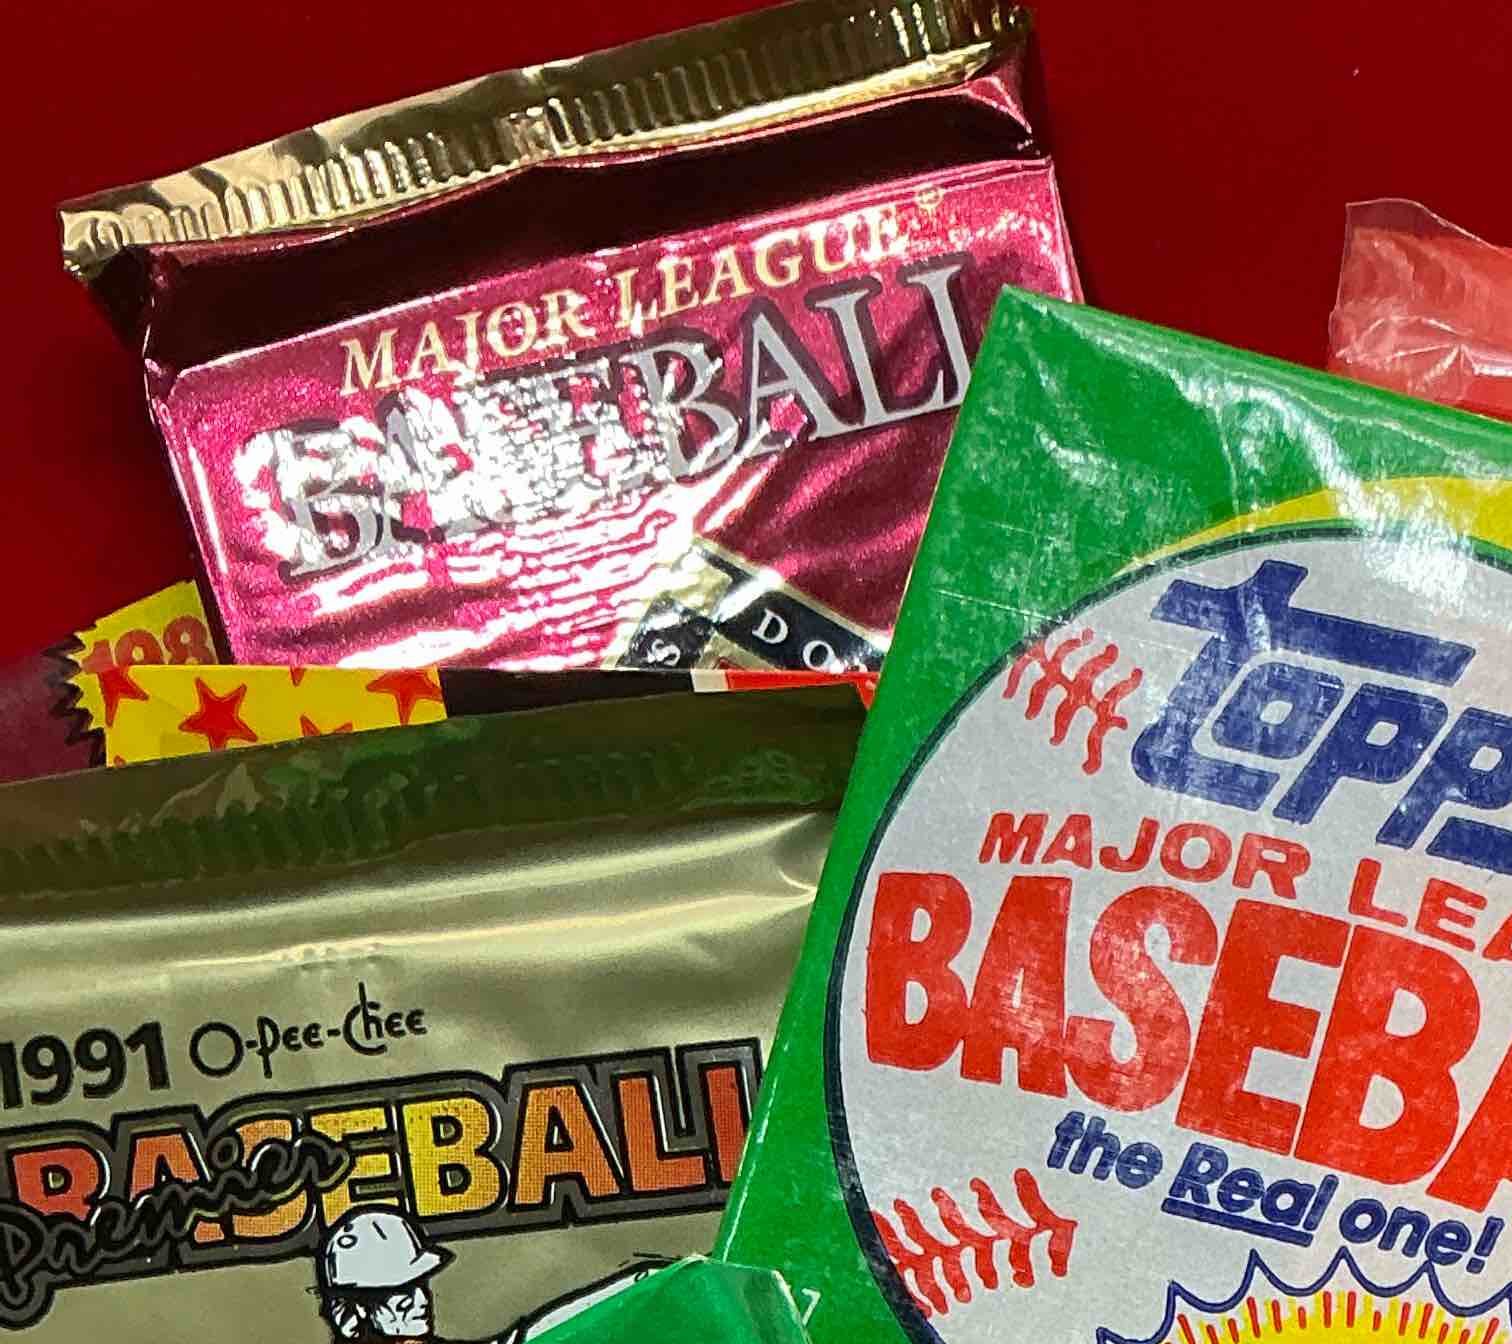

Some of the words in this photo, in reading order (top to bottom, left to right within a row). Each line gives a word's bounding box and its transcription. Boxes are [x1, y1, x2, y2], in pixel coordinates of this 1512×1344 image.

[340, 288, 598, 397] MAJOR
[615, 206, 910, 328] LEAGUE
[980, 810, 1312, 901] MAJOR
[0, 1022, 171, 1107] 1991
[1046, 1109, 1165, 1190] the
[1160, 1142, 1338, 1248] Real
[1338, 1193, 1502, 1274] one!
